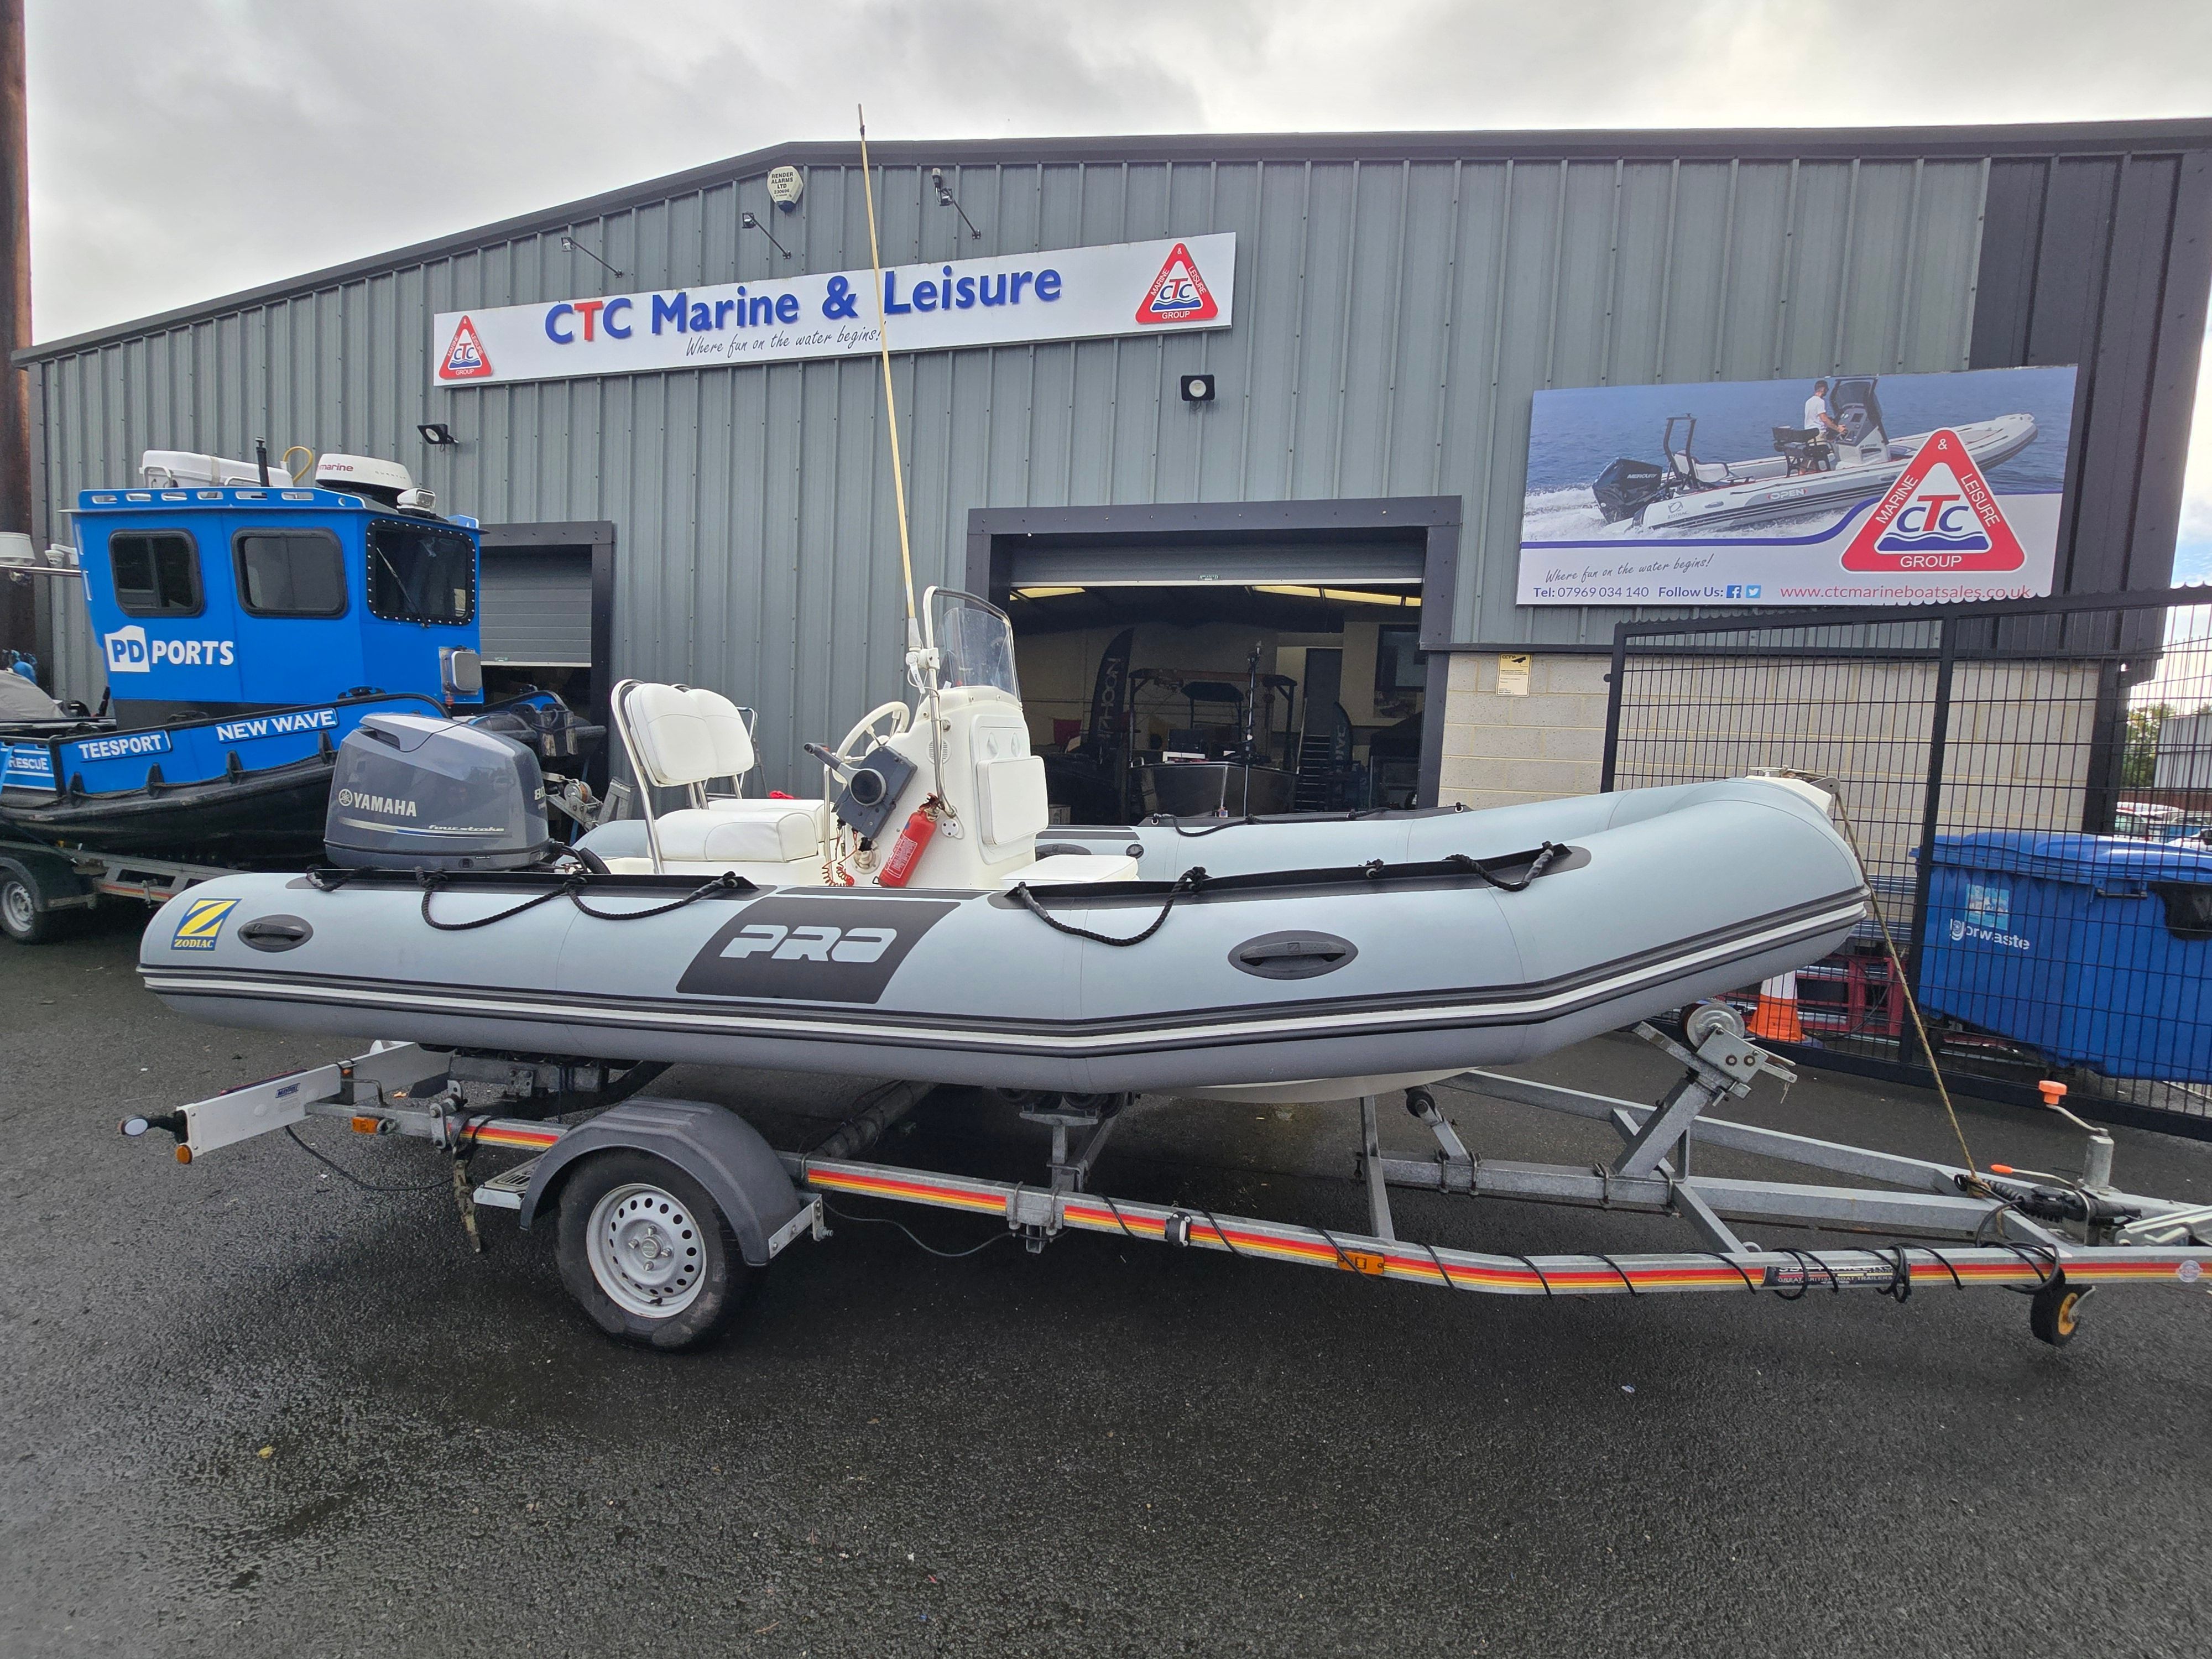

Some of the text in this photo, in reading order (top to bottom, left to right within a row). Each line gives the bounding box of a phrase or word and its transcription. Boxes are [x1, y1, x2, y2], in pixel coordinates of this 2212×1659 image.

[1150, 268, 1170, 296] MARINE
[1160, 278, 1192, 300] CTC
[1188, 265, 1207, 295] LEISURE
[545, 265, 1061, 344] CTC Marine & Leisure
[1162, 311, 1191, 319] GROUP
[453, 342, 474, 360] CTC
[686, 335, 724, 356] Where
[727, 333, 747, 358] fun
[753, 339, 765, 350] on
[770, 330, 790, 348] the
[795, 330, 833, 346] water
[1938, 438, 1948, 450] &
[317, 463, 354, 472] marine
[1770, 489, 1805, 500] OPEN
[1875, 474, 1918, 525] MARINE
[1960, 473, 2000, 527] LEISURE
[1896, 494, 1969, 533] CTC
[1545, 554, 1714, 583] Where fun on the water begins!
[1900, 555, 1963, 568] GROUP
[1533, 587, 1555, 598] Tel:
[1557, 587, 1597, 598] 07969
[1599, 587, 1623, 598] 034
[1626, 587, 1649, 598] 140
[1658, 586, 1701, 598] Follow
[1704, 587, 1724, 598] Us:
[1780, 584, 2032, 599] www.ctcmarineboatsales.couk
[111, 639, 234, 665] PD PORTS
[216, 710, 336, 741] NEW WAVE
[79, 734, 162, 760] TEESPORT
[9, 757, 49, 770] RESCUE
[353, 792, 417, 817] YAMAHA
[174, 939, 214, 948] ZODIAC
[719, 924, 897, 963] PRO
